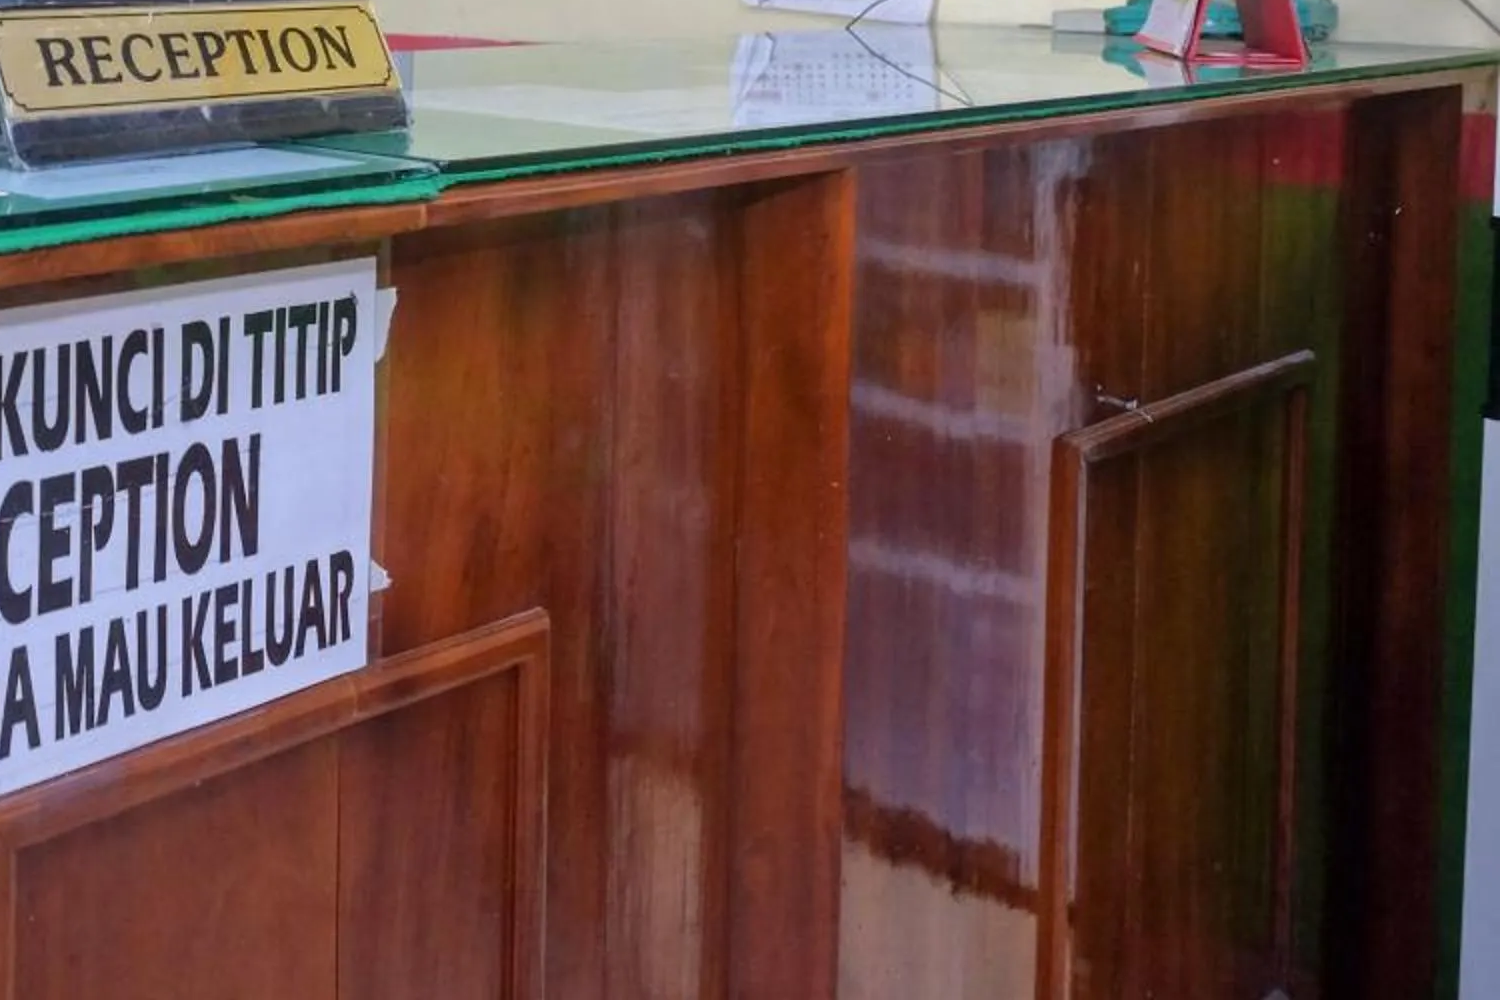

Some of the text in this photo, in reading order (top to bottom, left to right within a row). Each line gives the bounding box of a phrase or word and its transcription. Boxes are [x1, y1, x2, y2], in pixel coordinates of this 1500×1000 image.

[36, 25, 357, 88] RECEPTION
[181, 316, 231, 423] DI
[243, 292, 357, 410] TITIP
[54, 603, 168, 742] MAU
[182, 549, 355, 699] KELUAR
